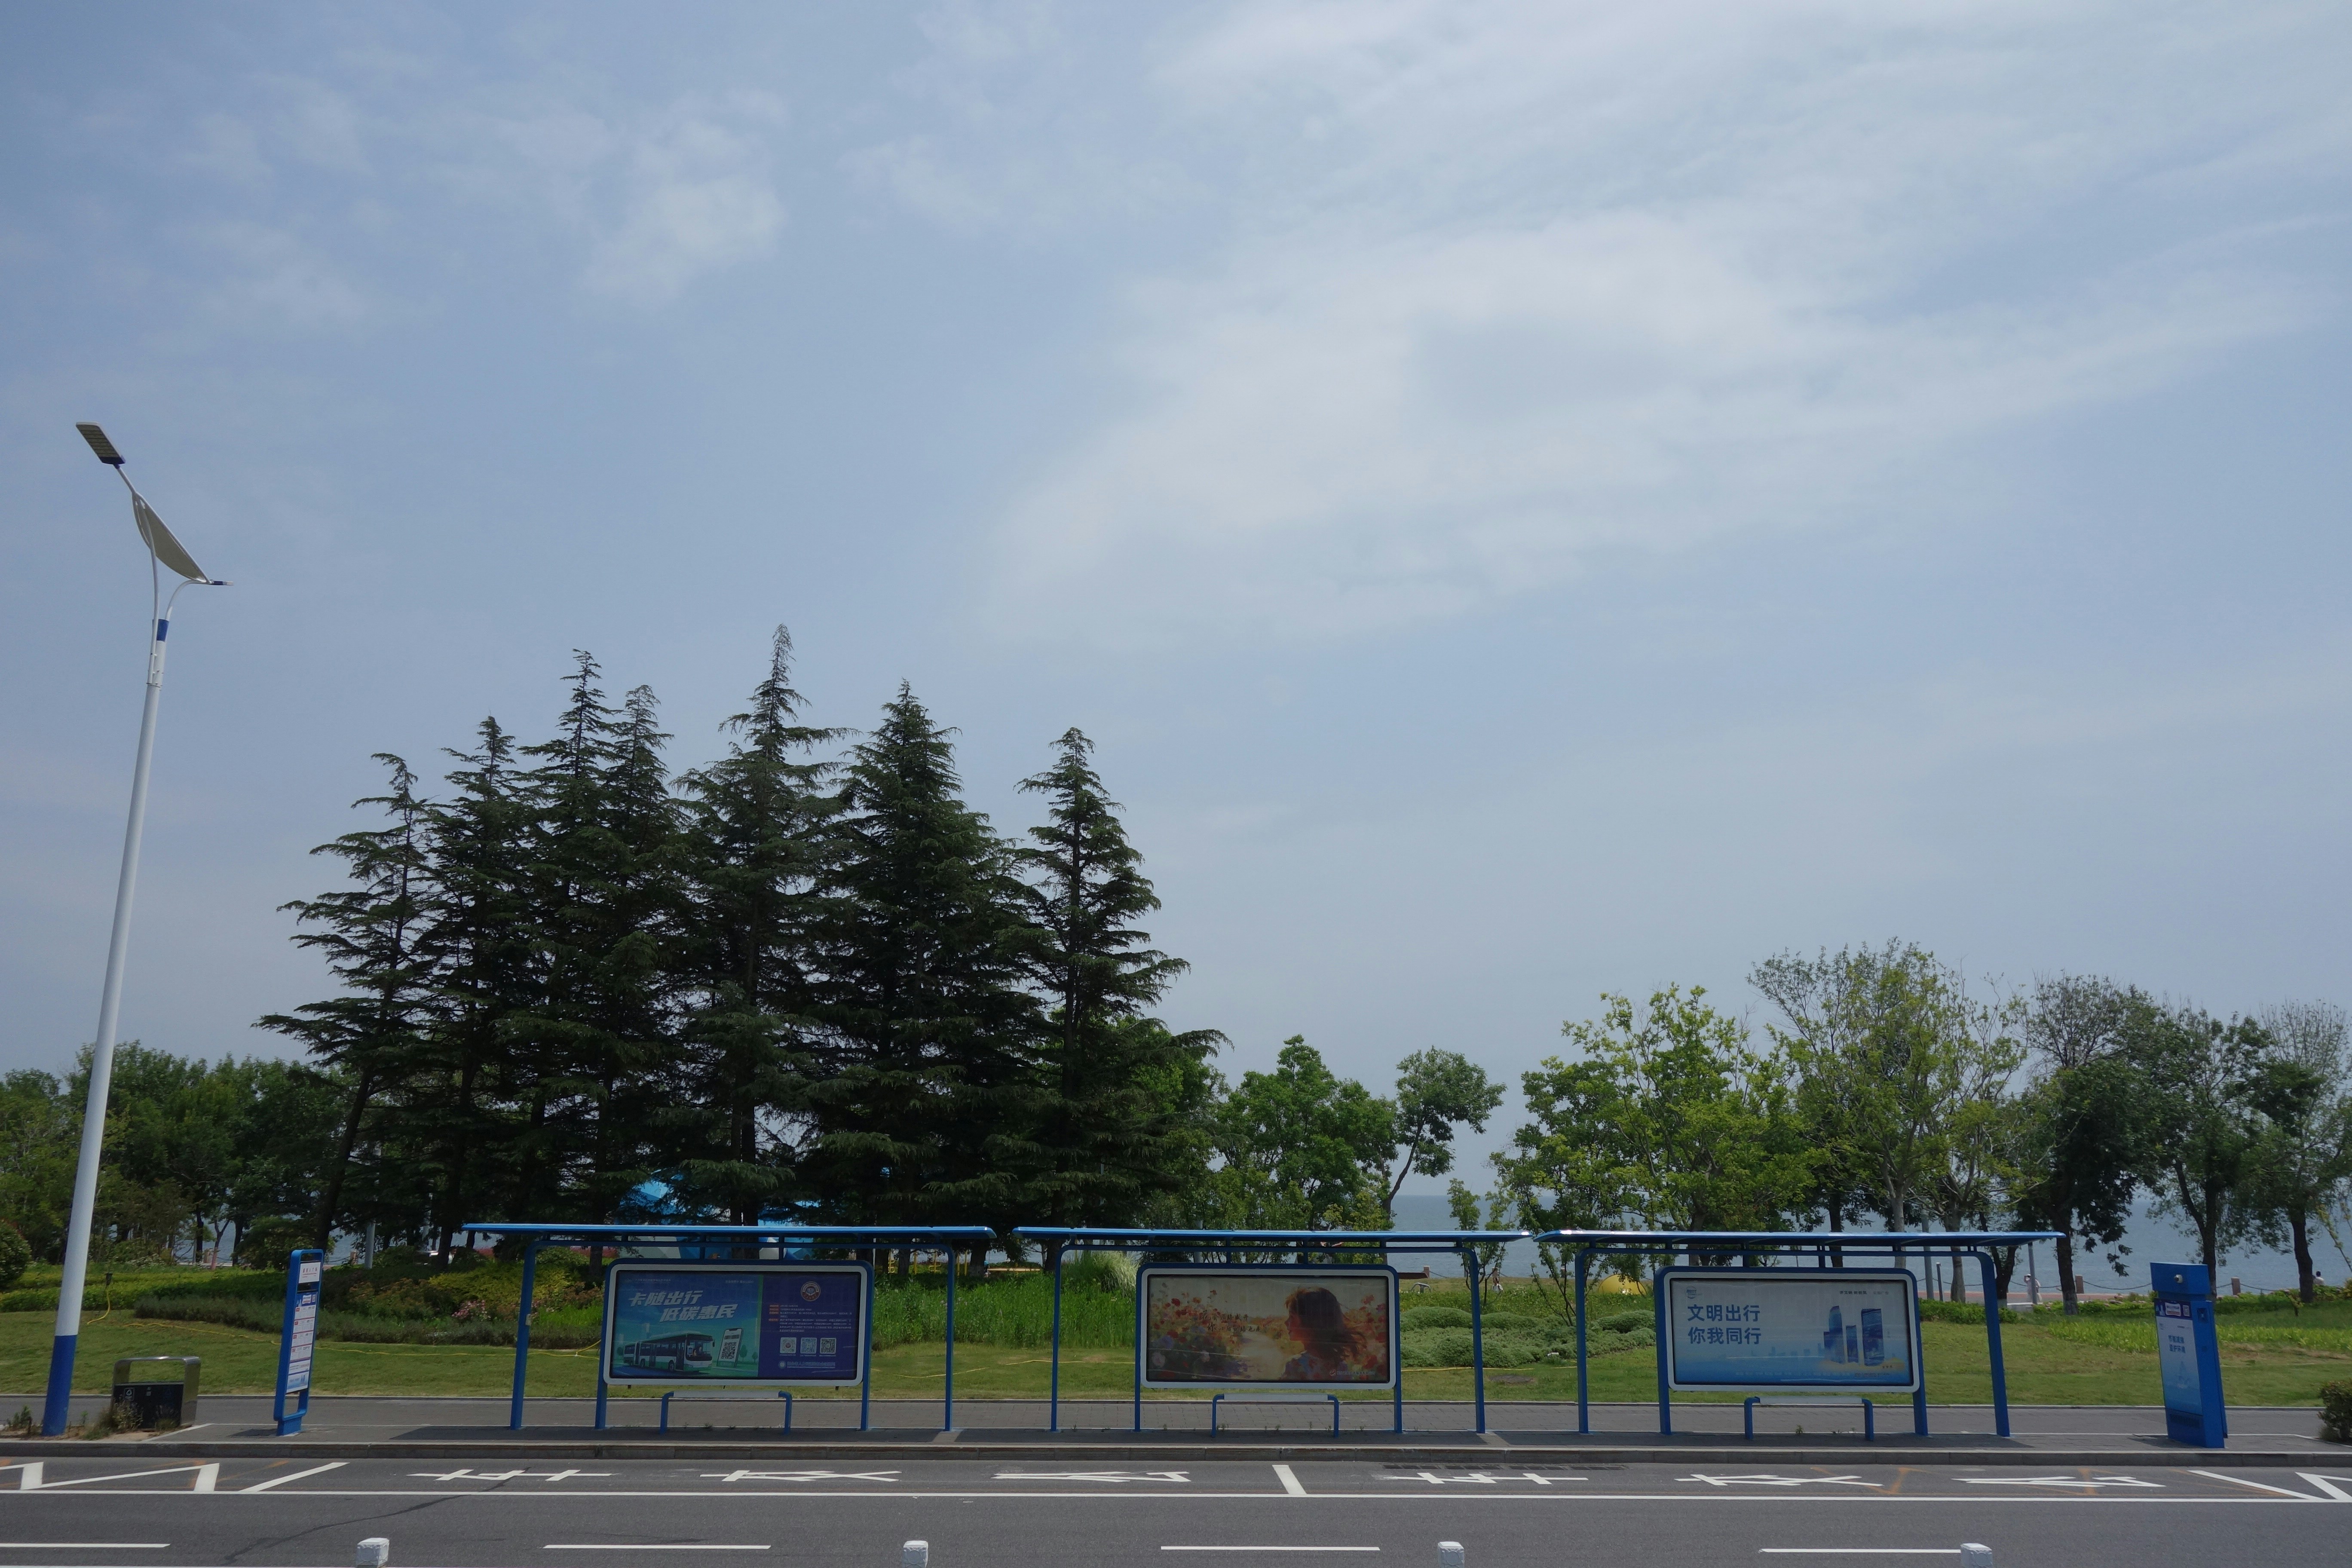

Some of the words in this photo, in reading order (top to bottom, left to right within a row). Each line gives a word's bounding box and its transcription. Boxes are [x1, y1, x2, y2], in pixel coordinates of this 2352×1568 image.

[628, 1290, 703, 1307] 卡随出行
[659, 1304, 739, 1322] 低碳惠民
[1687, 1304, 1760, 1322] 文明出行
[1688, 1327, 1761, 1344] 你我同行
